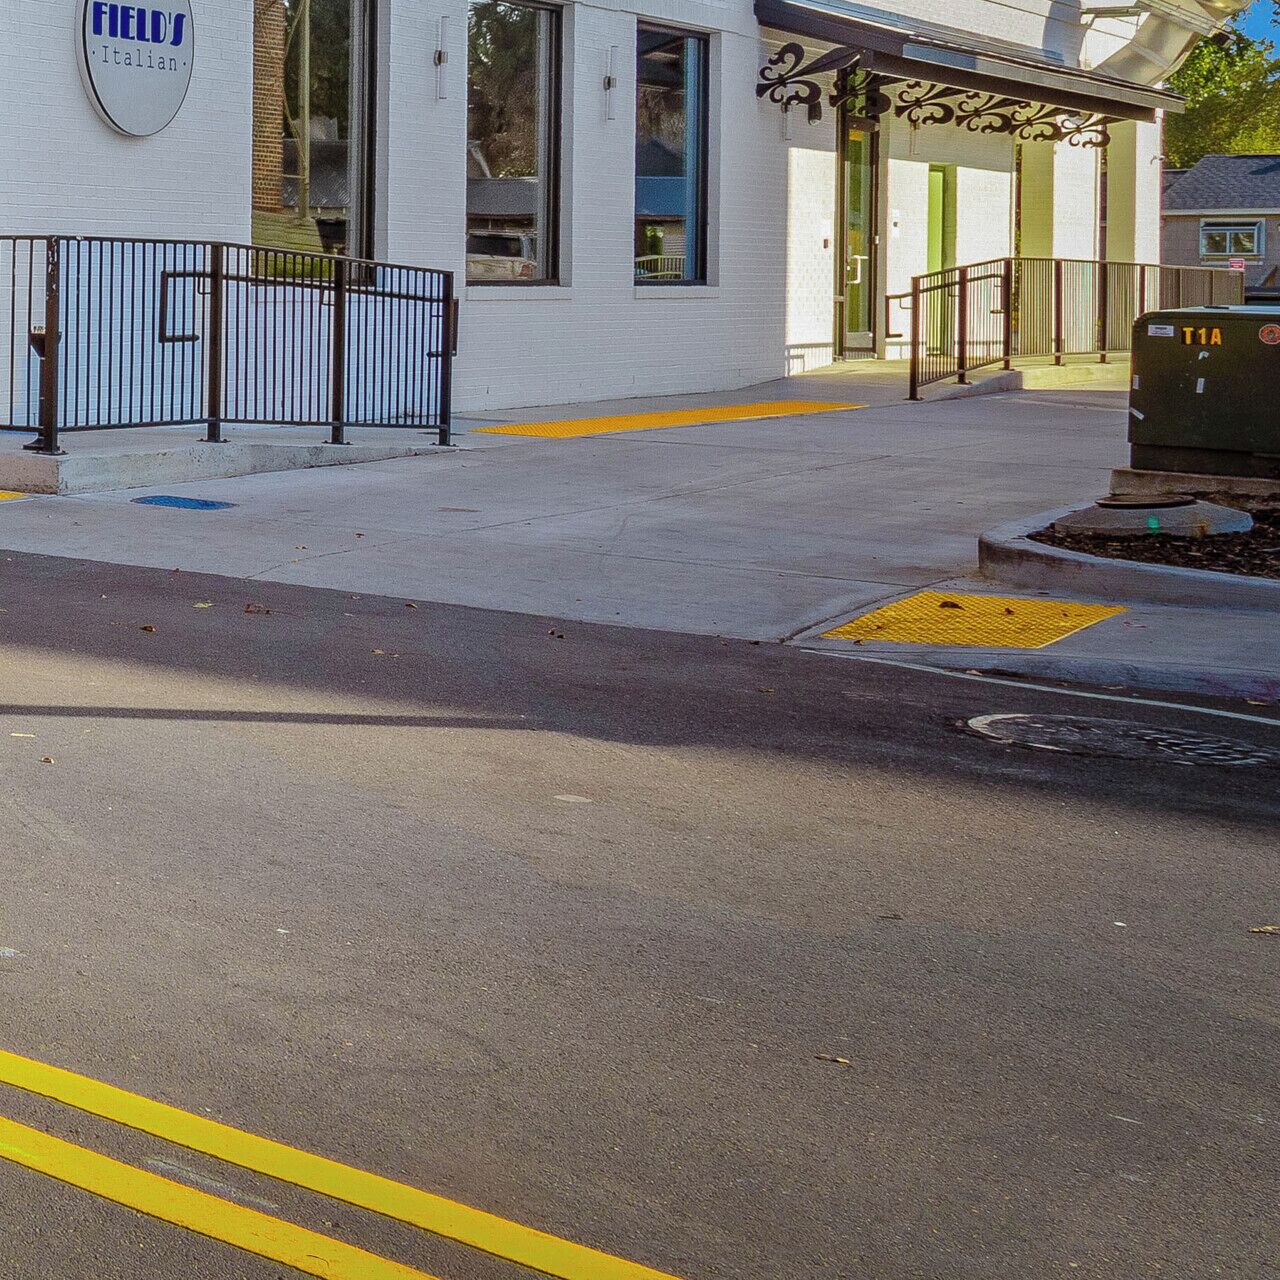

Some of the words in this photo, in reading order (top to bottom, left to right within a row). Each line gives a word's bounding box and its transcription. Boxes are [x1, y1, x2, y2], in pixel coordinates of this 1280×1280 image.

[92, 0, 187, 47] FIELD'S
[102, 45, 178, 72] Italian
[1182, 327, 1222, 346] T1A
